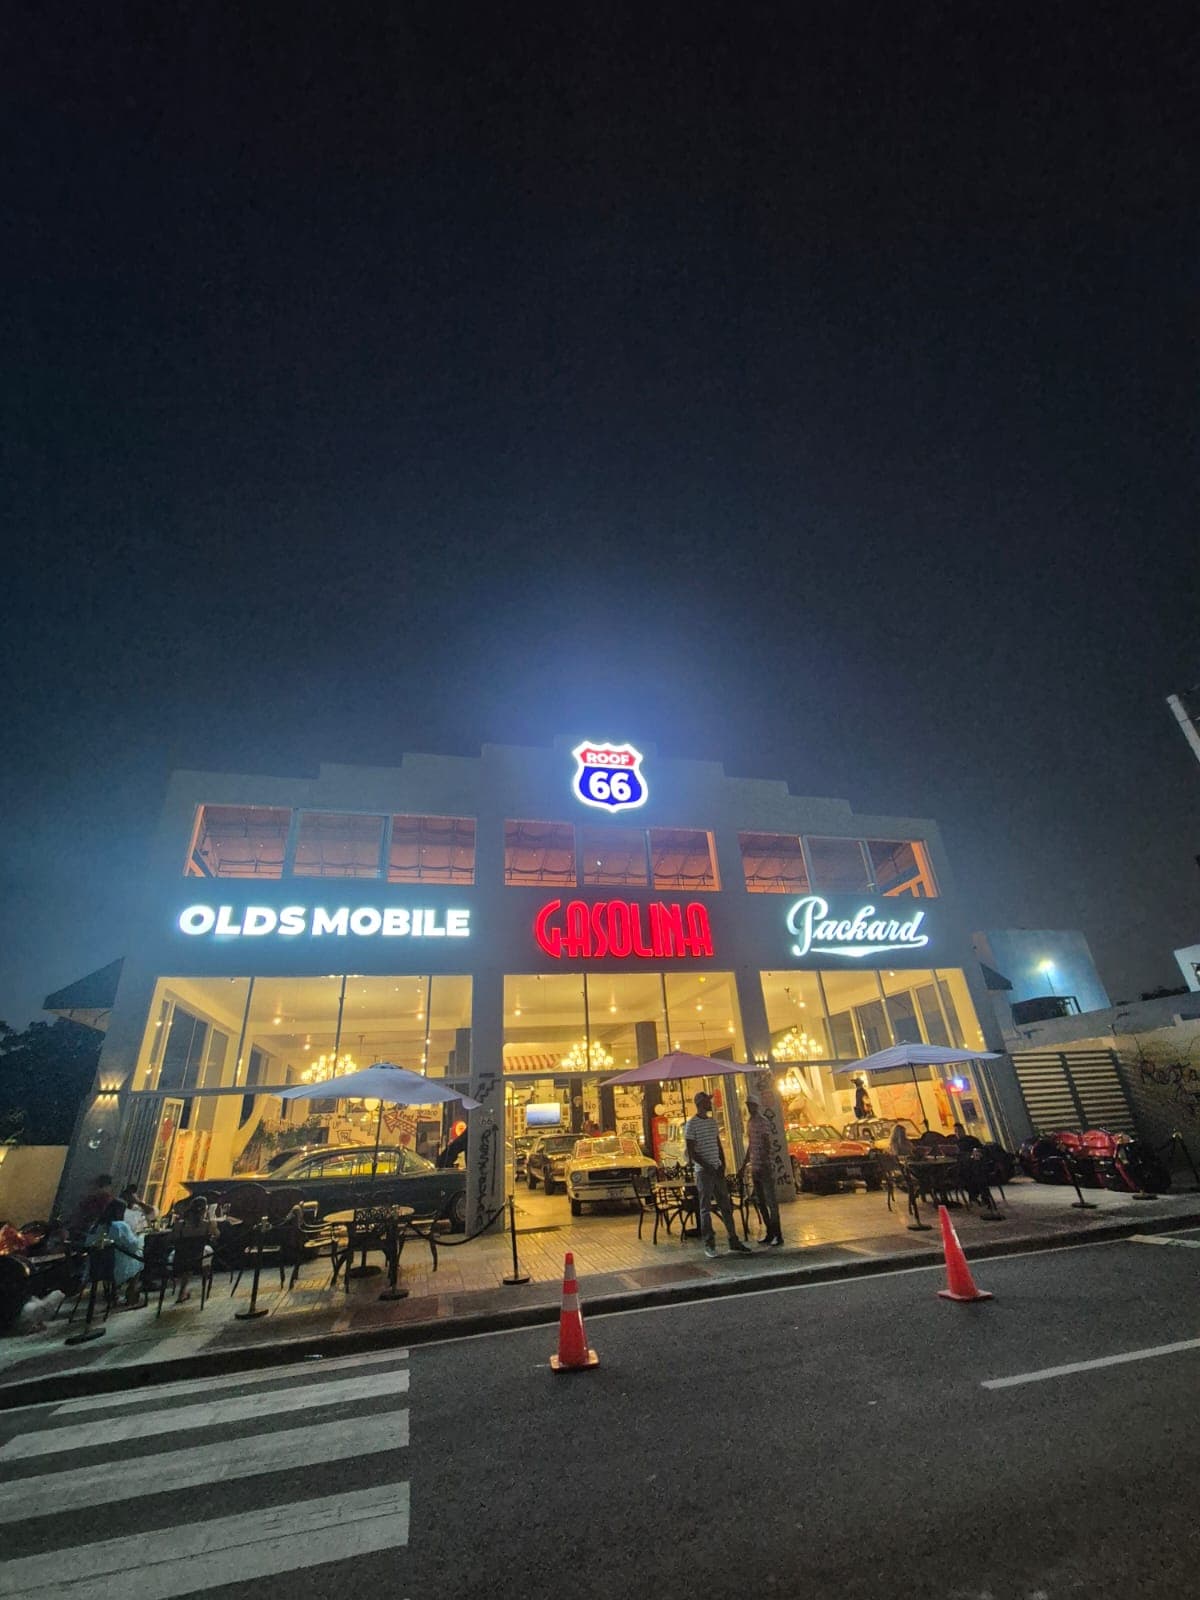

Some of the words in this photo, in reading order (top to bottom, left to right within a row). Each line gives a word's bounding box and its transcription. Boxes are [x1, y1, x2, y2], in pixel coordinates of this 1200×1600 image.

[586, 752, 630, 765] ROOF
[589, 771, 632, 801] 66
[535, 899, 715, 959] GASOLINA
[786, 896, 929, 957] Packard
